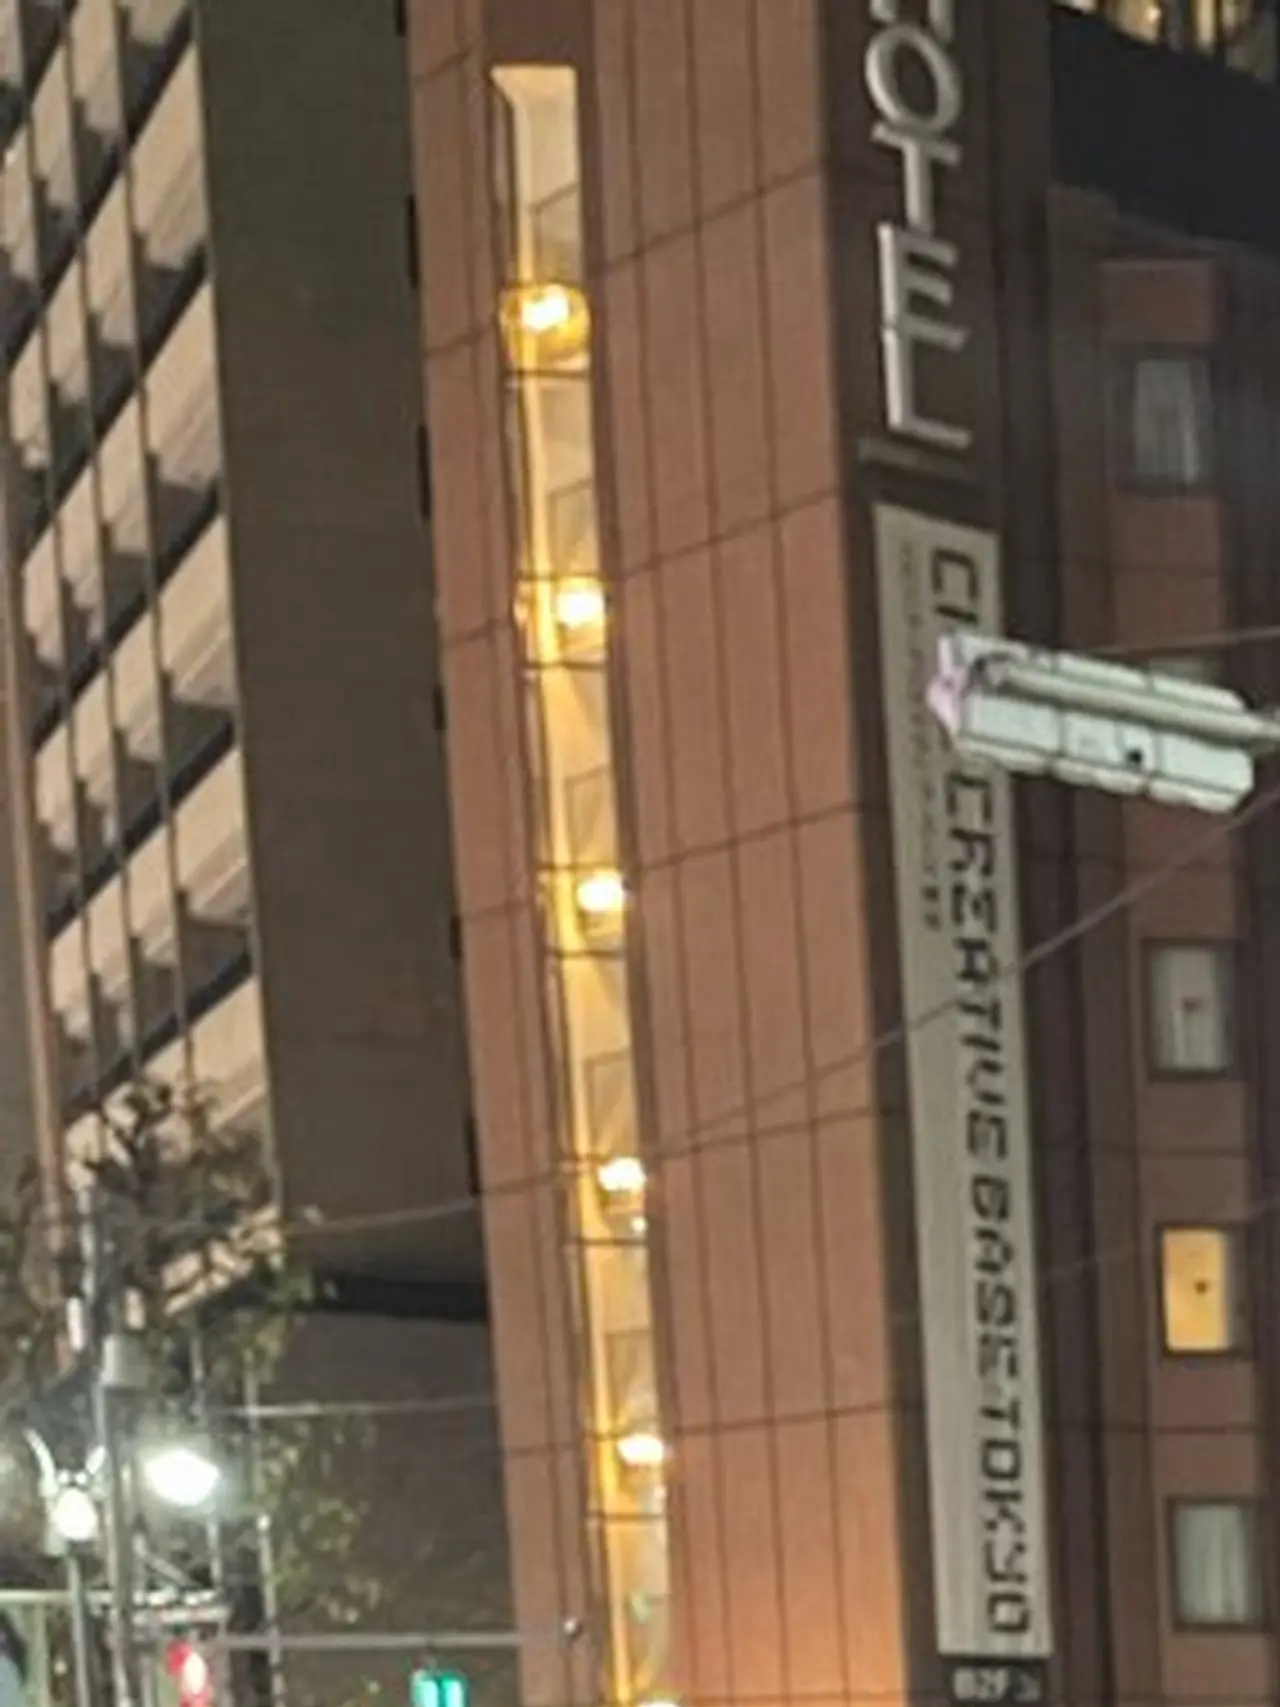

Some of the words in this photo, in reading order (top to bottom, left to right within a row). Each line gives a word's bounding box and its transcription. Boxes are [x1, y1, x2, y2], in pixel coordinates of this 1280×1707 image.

[946, 772, 1009, 1158] CREATIVE
[970, 1173, 1020, 1379] BASE
[979, 1399, 1030, 1635] TOKYO
